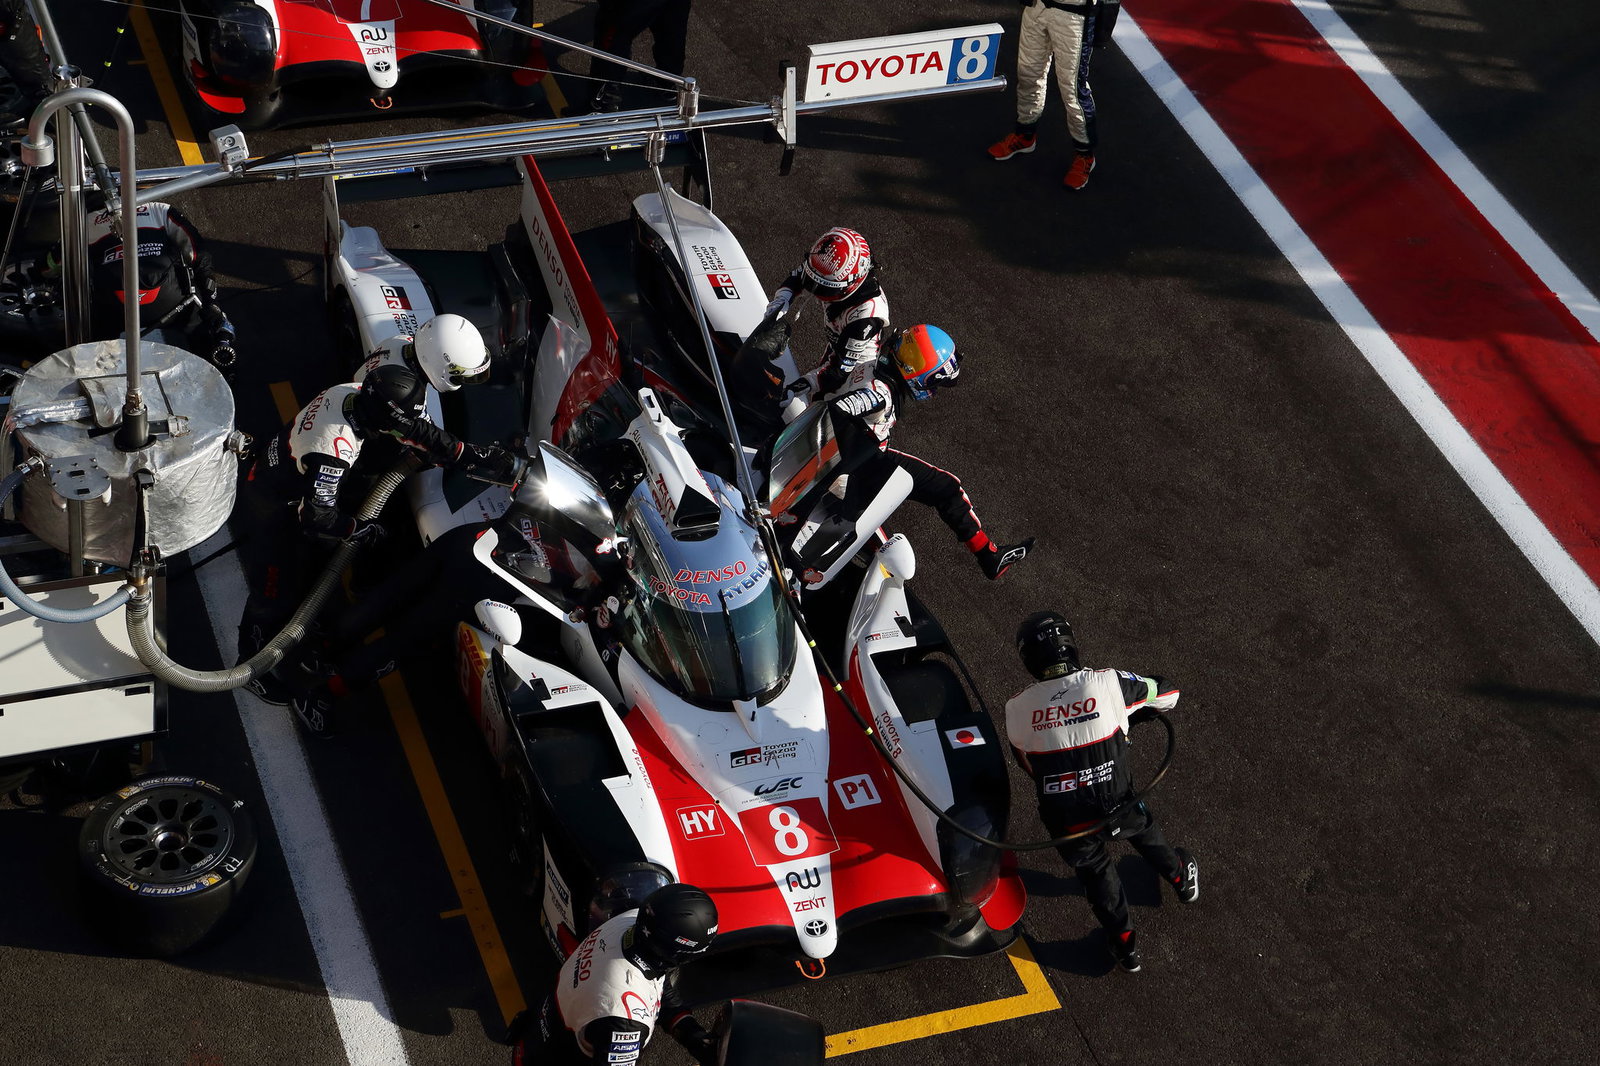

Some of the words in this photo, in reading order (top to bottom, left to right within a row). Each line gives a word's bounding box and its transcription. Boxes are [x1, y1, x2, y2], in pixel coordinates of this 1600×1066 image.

[365, 46, 390, 55] ZENT
[816, 51, 944, 86] TOYOTA
[956, 35, 990, 80] 8
[532, 216, 563, 287] DENSO
[692, 245, 710, 271] TOYOTA
[701, 246, 718, 271] GAZOO
[709, 246, 726, 271] Racing
[381, 286, 404, 310] GR
[714, 274, 740, 299] GR
[400, 313, 415, 337] GAZO
[322, 467, 342, 475] JTEKT
[674, 560, 748, 584] DENSO
[721, 561, 769, 600] HYBRID
[649, 574, 712, 605] TOYOTA
[1032, 697, 1097, 725] DENSO
[1032, 719, 1064, 732] TOYOTA
[1065, 711, 1100, 727] HYBRID
[875, 715, 893, 751] HYBRID
[881, 710, 900, 745] TOYOTA
[893, 747, 902, 759] 8
[763, 741, 798, 751] TOYOTA
[763, 747, 796, 756] GAZOO
[764, 752, 796, 762] Racing
[731, 750, 762, 768] GR
[1079, 760, 1115, 777] TOYOTA
[140, 776, 194, 788] MICHELIN
[754, 777, 803, 796] WEC
[1045, 778, 1076, 793] GR
[1080, 767, 1113, 783] GAZOO
[841, 779, 875, 804] P1
[680, 809, 716, 835] HY
[769, 805, 809, 856] 8
[141, 883, 197, 895] MICHELIN
[793, 896, 827, 913] ZENT
[579, 929, 602, 982] DENSO
[613, 1043, 638, 1051] AISIN
[614, 1033, 639, 1042] JTEKT
